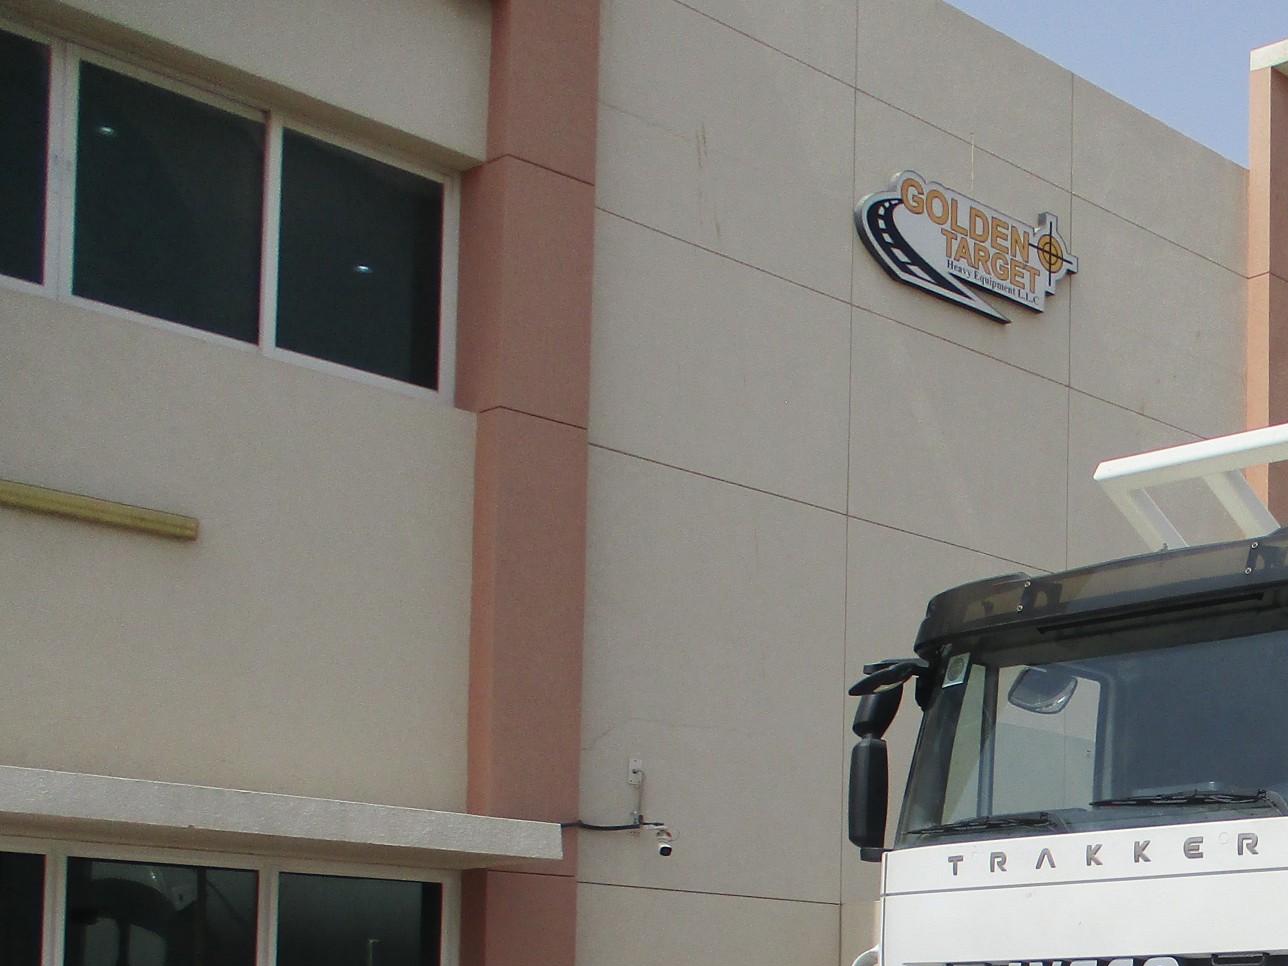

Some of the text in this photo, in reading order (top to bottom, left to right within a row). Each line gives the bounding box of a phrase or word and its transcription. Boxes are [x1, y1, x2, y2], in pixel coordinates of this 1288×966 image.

[901, 178, 1030, 263] GOLDEN
[941, 227, 1041, 294] TARGET
[947, 259, 971, 279] Heavy
[974, 271, 1016, 296] Equipment
[947, 831, 1259, 877] TRAKKER
